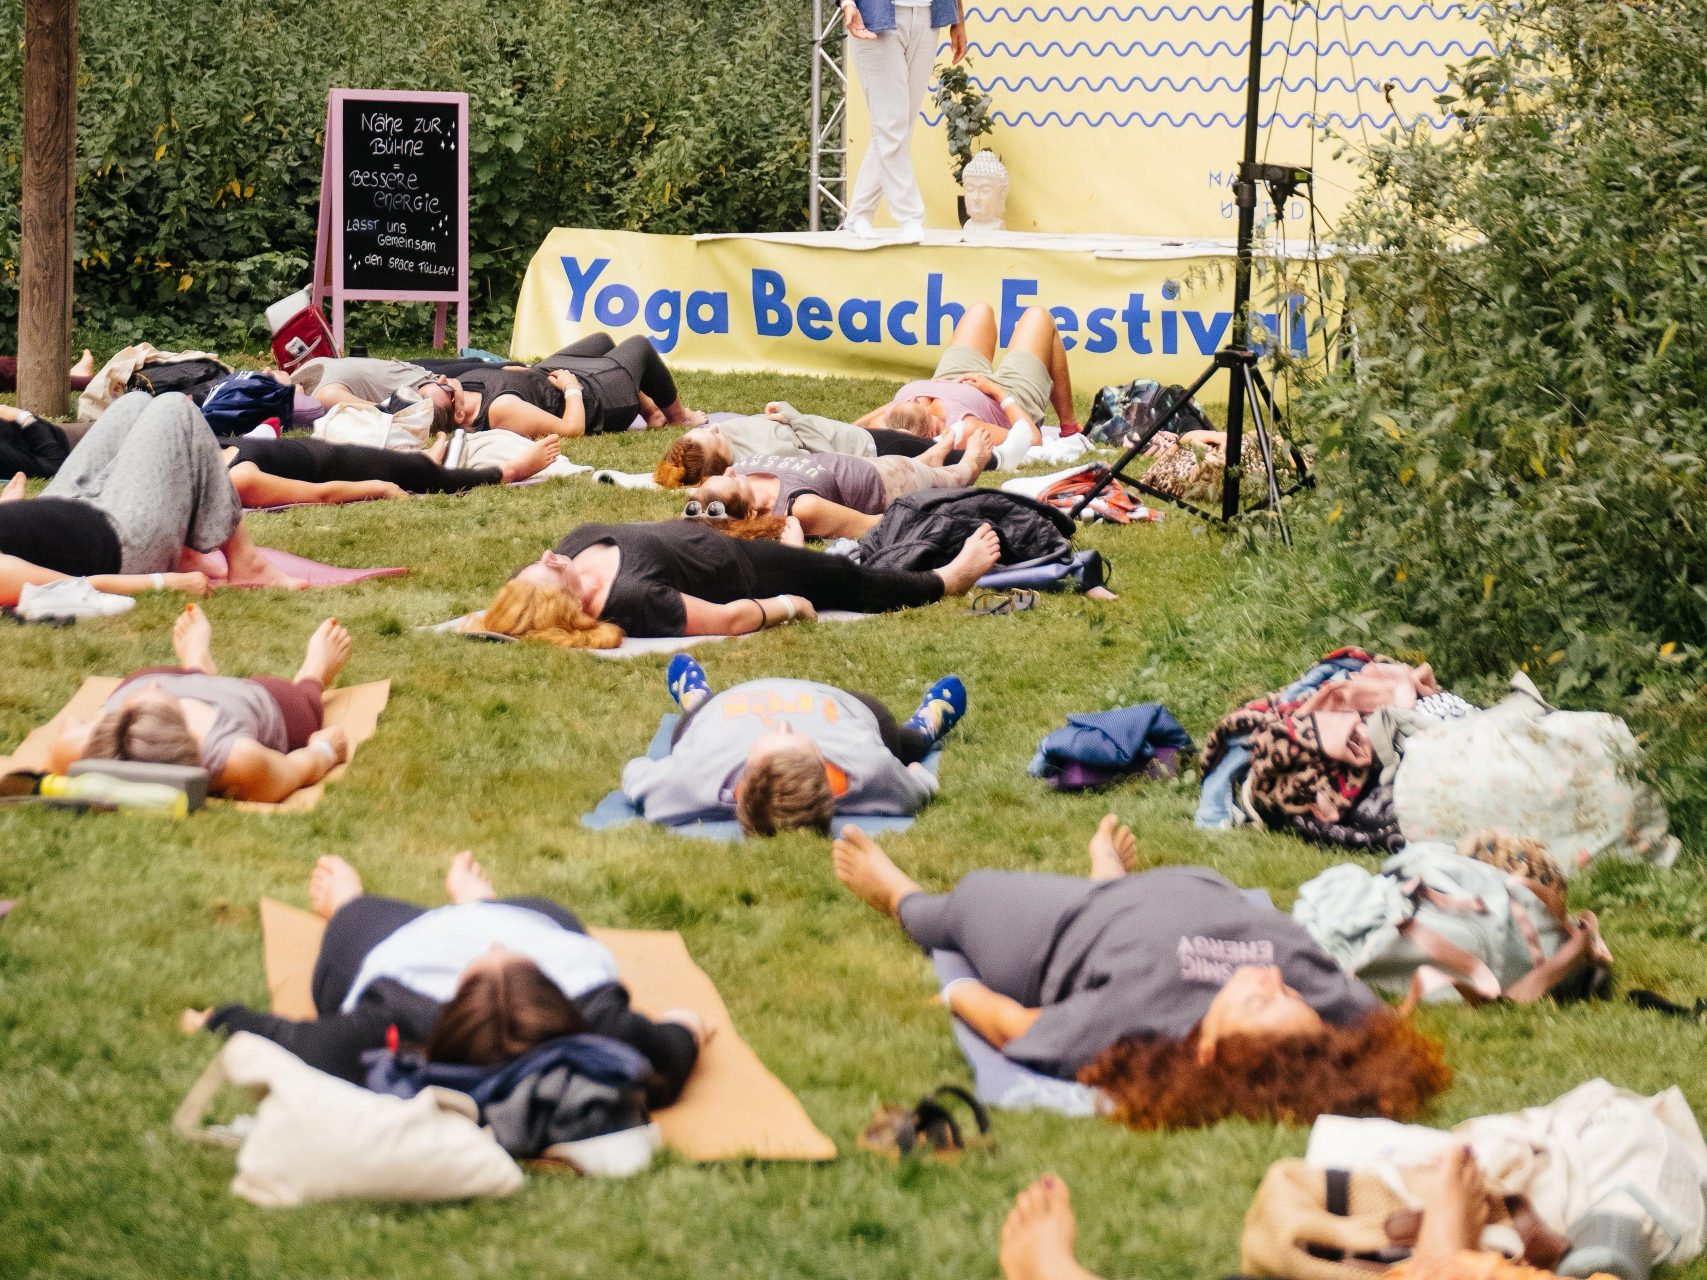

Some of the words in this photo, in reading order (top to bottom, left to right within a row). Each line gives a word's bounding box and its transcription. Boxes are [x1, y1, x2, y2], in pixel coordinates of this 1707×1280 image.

[361, 112, 403, 136] Nähe
[386, 221, 407, 234] uns
[364, 253, 383, 266] den
[560, 255, 729, 354] Yoga
[751, 268, 966, 346] Beach
